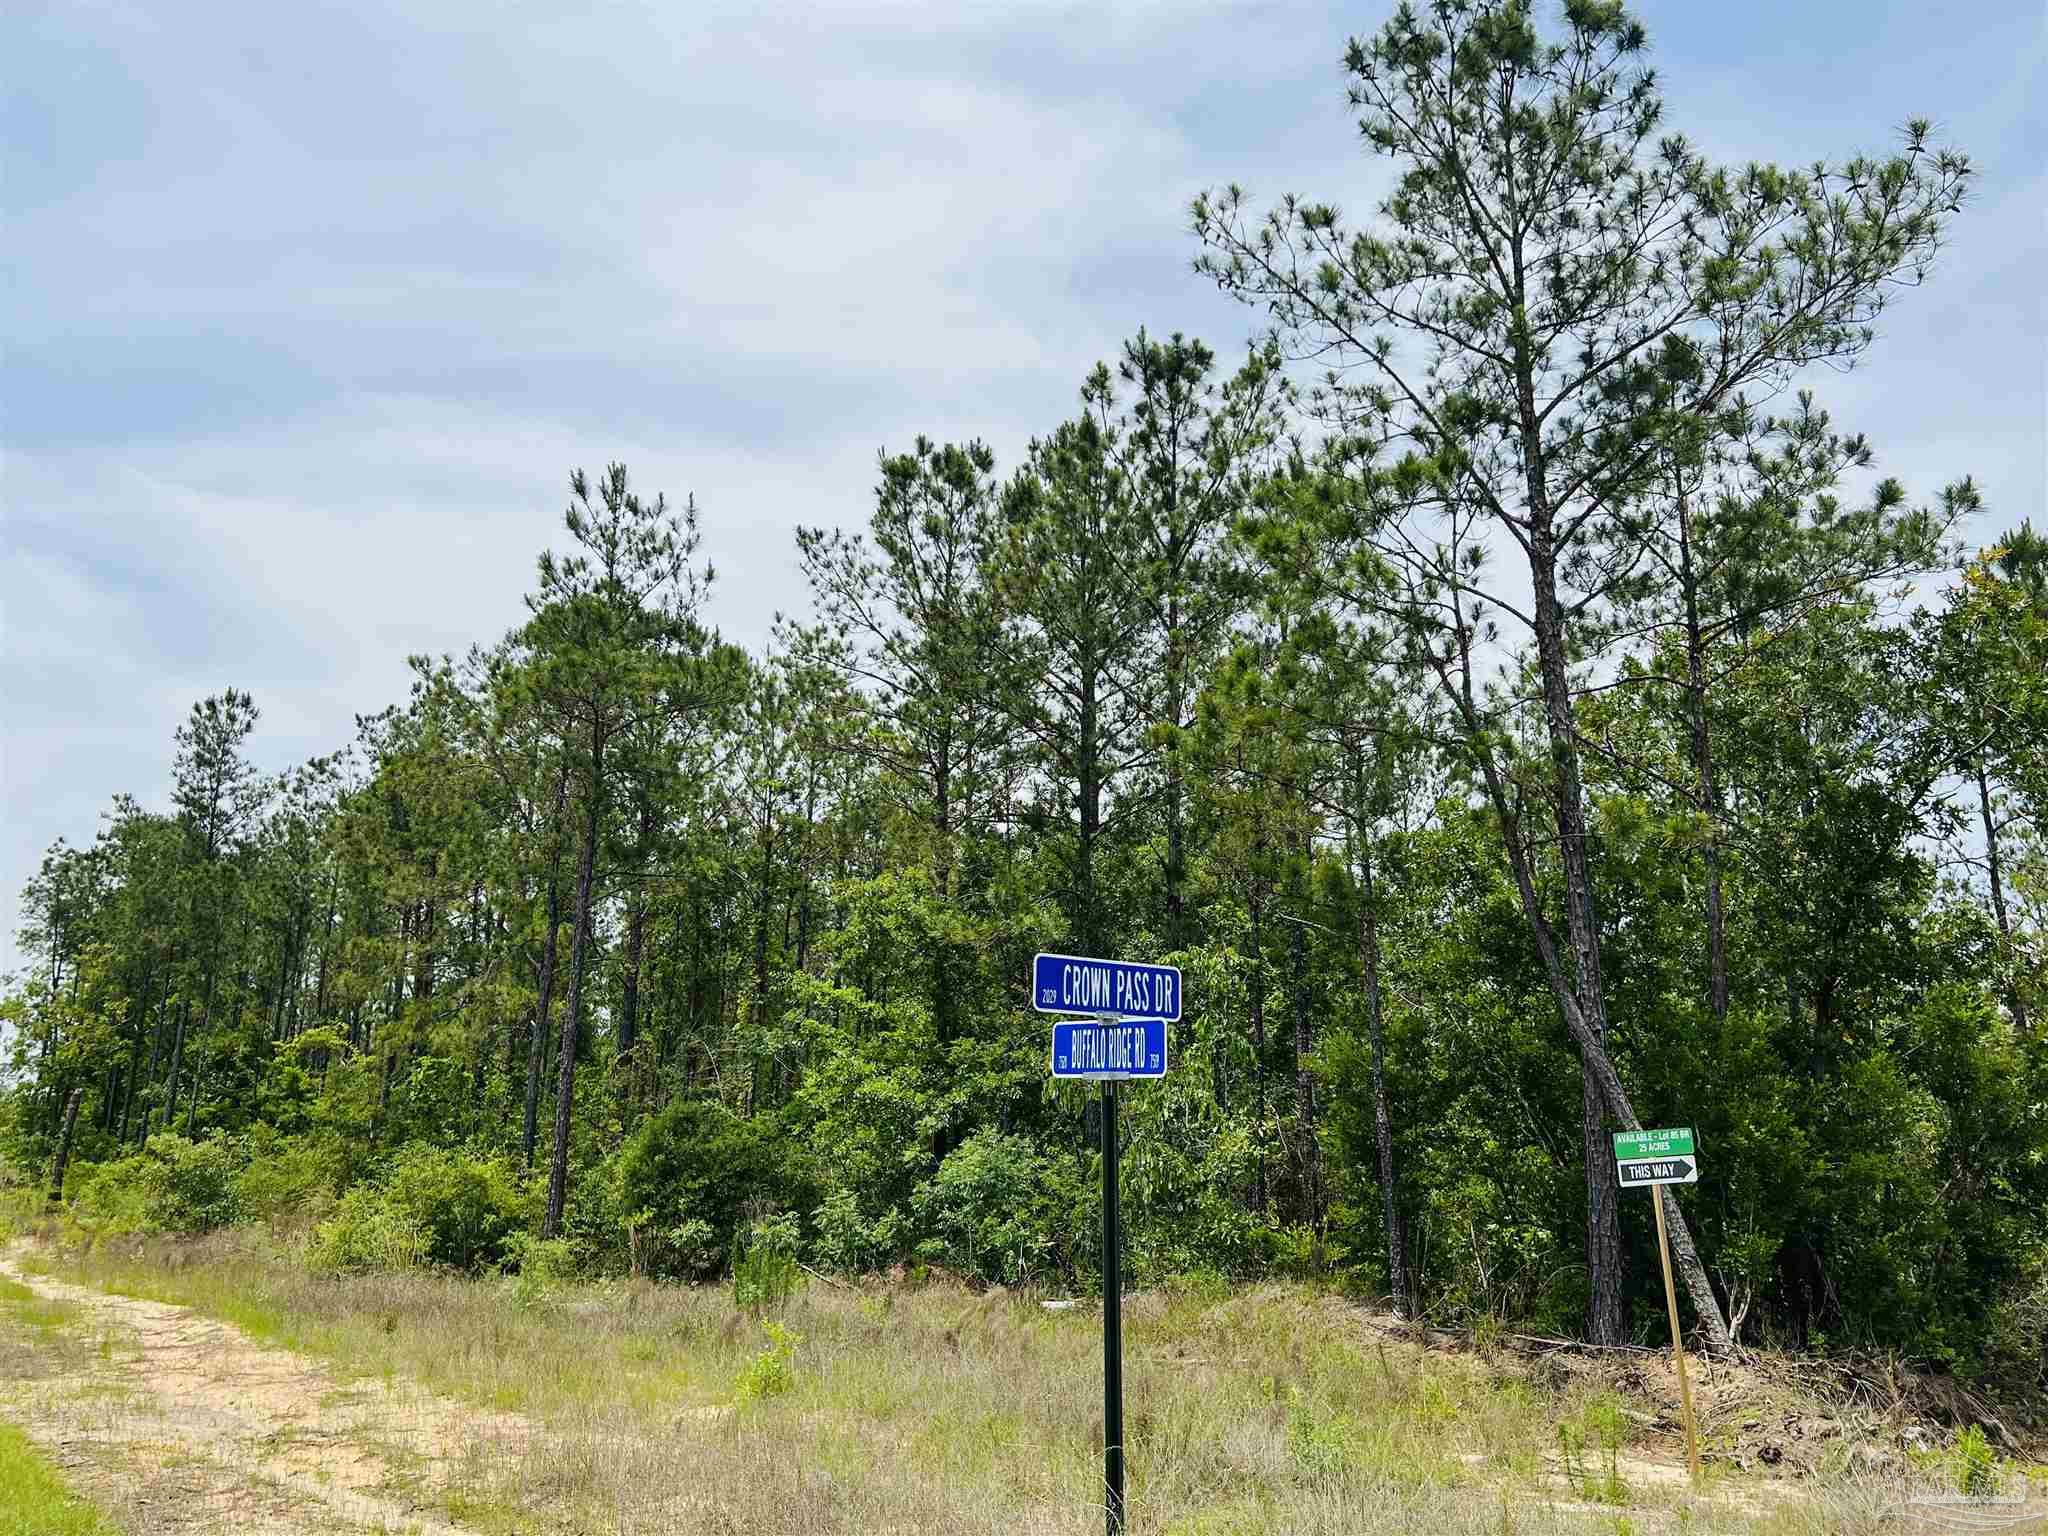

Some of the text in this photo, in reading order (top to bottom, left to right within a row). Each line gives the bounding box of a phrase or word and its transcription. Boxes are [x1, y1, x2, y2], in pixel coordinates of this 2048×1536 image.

[1063, 964, 1173, 1014] CROWN PASS DR
[1071, 1027, 1146, 1069] BUFFALO RIDGE RD
[1648, 1141, 1671, 1153] ACRES
[1628, 1163, 1675, 1179] THIS WAY
